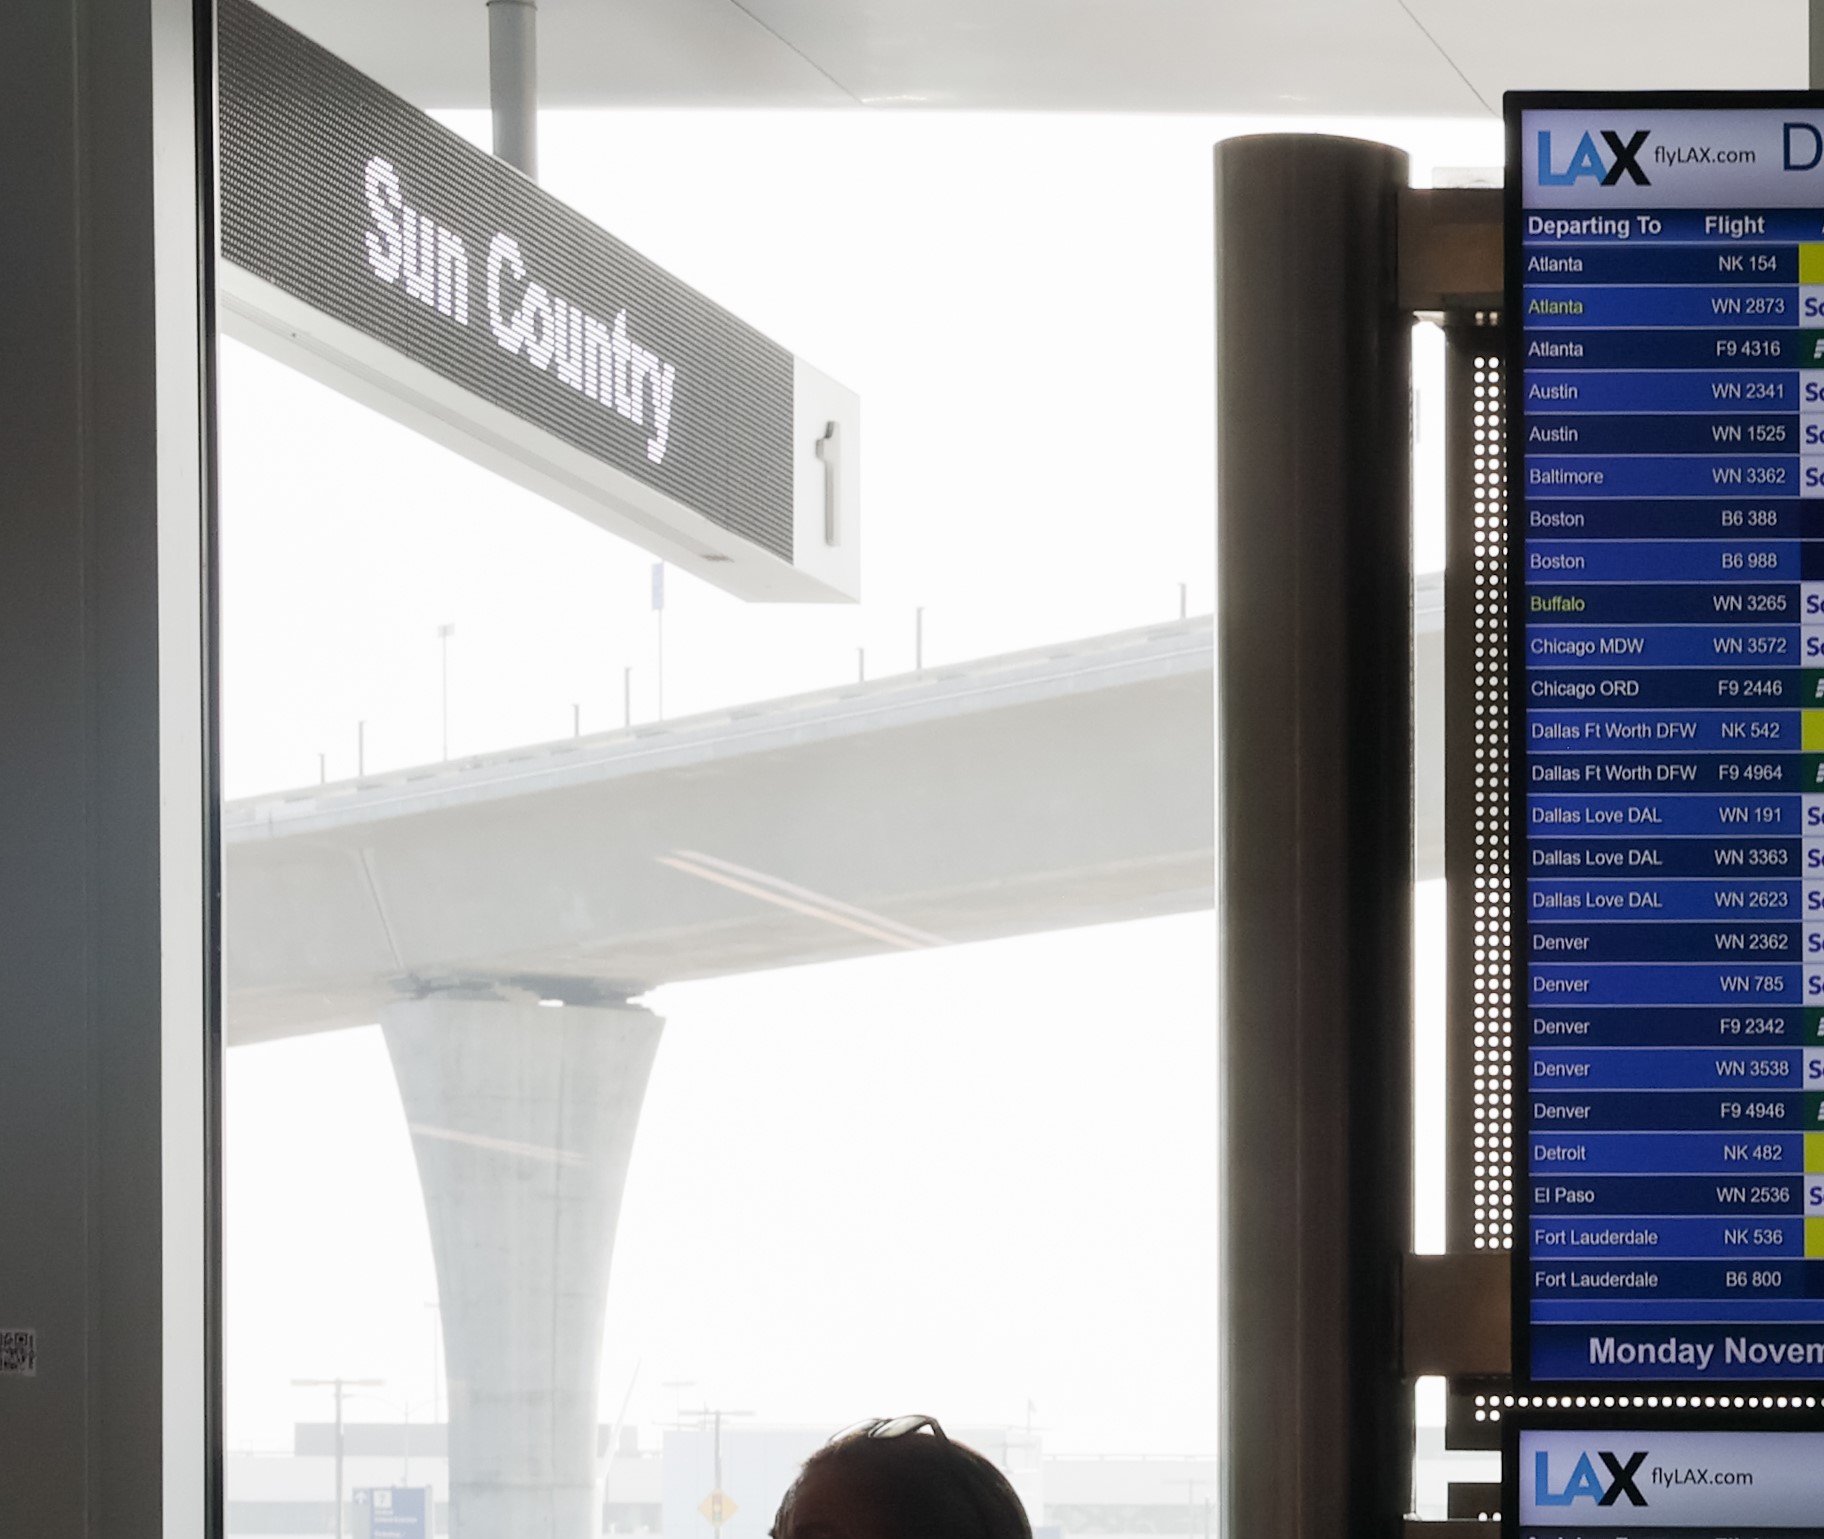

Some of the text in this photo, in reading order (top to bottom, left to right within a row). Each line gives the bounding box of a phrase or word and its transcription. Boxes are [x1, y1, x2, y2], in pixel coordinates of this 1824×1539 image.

[1538, 130, 1651, 186] LAX
[1655, 146, 1755, 166] flyLAX.com
[1529, 217, 1629, 238] Departing
[1637, 216, 1661, 234] To
[1706, 216, 1764, 238] Flight
[1528, 257, 1582, 271] Atlanta
[1719, 256, 1743, 271] NK
[1750, 256, 1776, 270] 154
[365, 157, 674, 465] Sun Country
[1528, 384, 1579, 399] Austin
[1712, 383, 1740, 398] WN
[1746, 383, 1782, 398] 2341
[816, 420, 840, 546] 1
[1590, 1338, 1713, 1369] Monday
[1535, 1451, 1649, 1506] LAX
[1652, 1468, 1752, 1488] flyLAX.com
